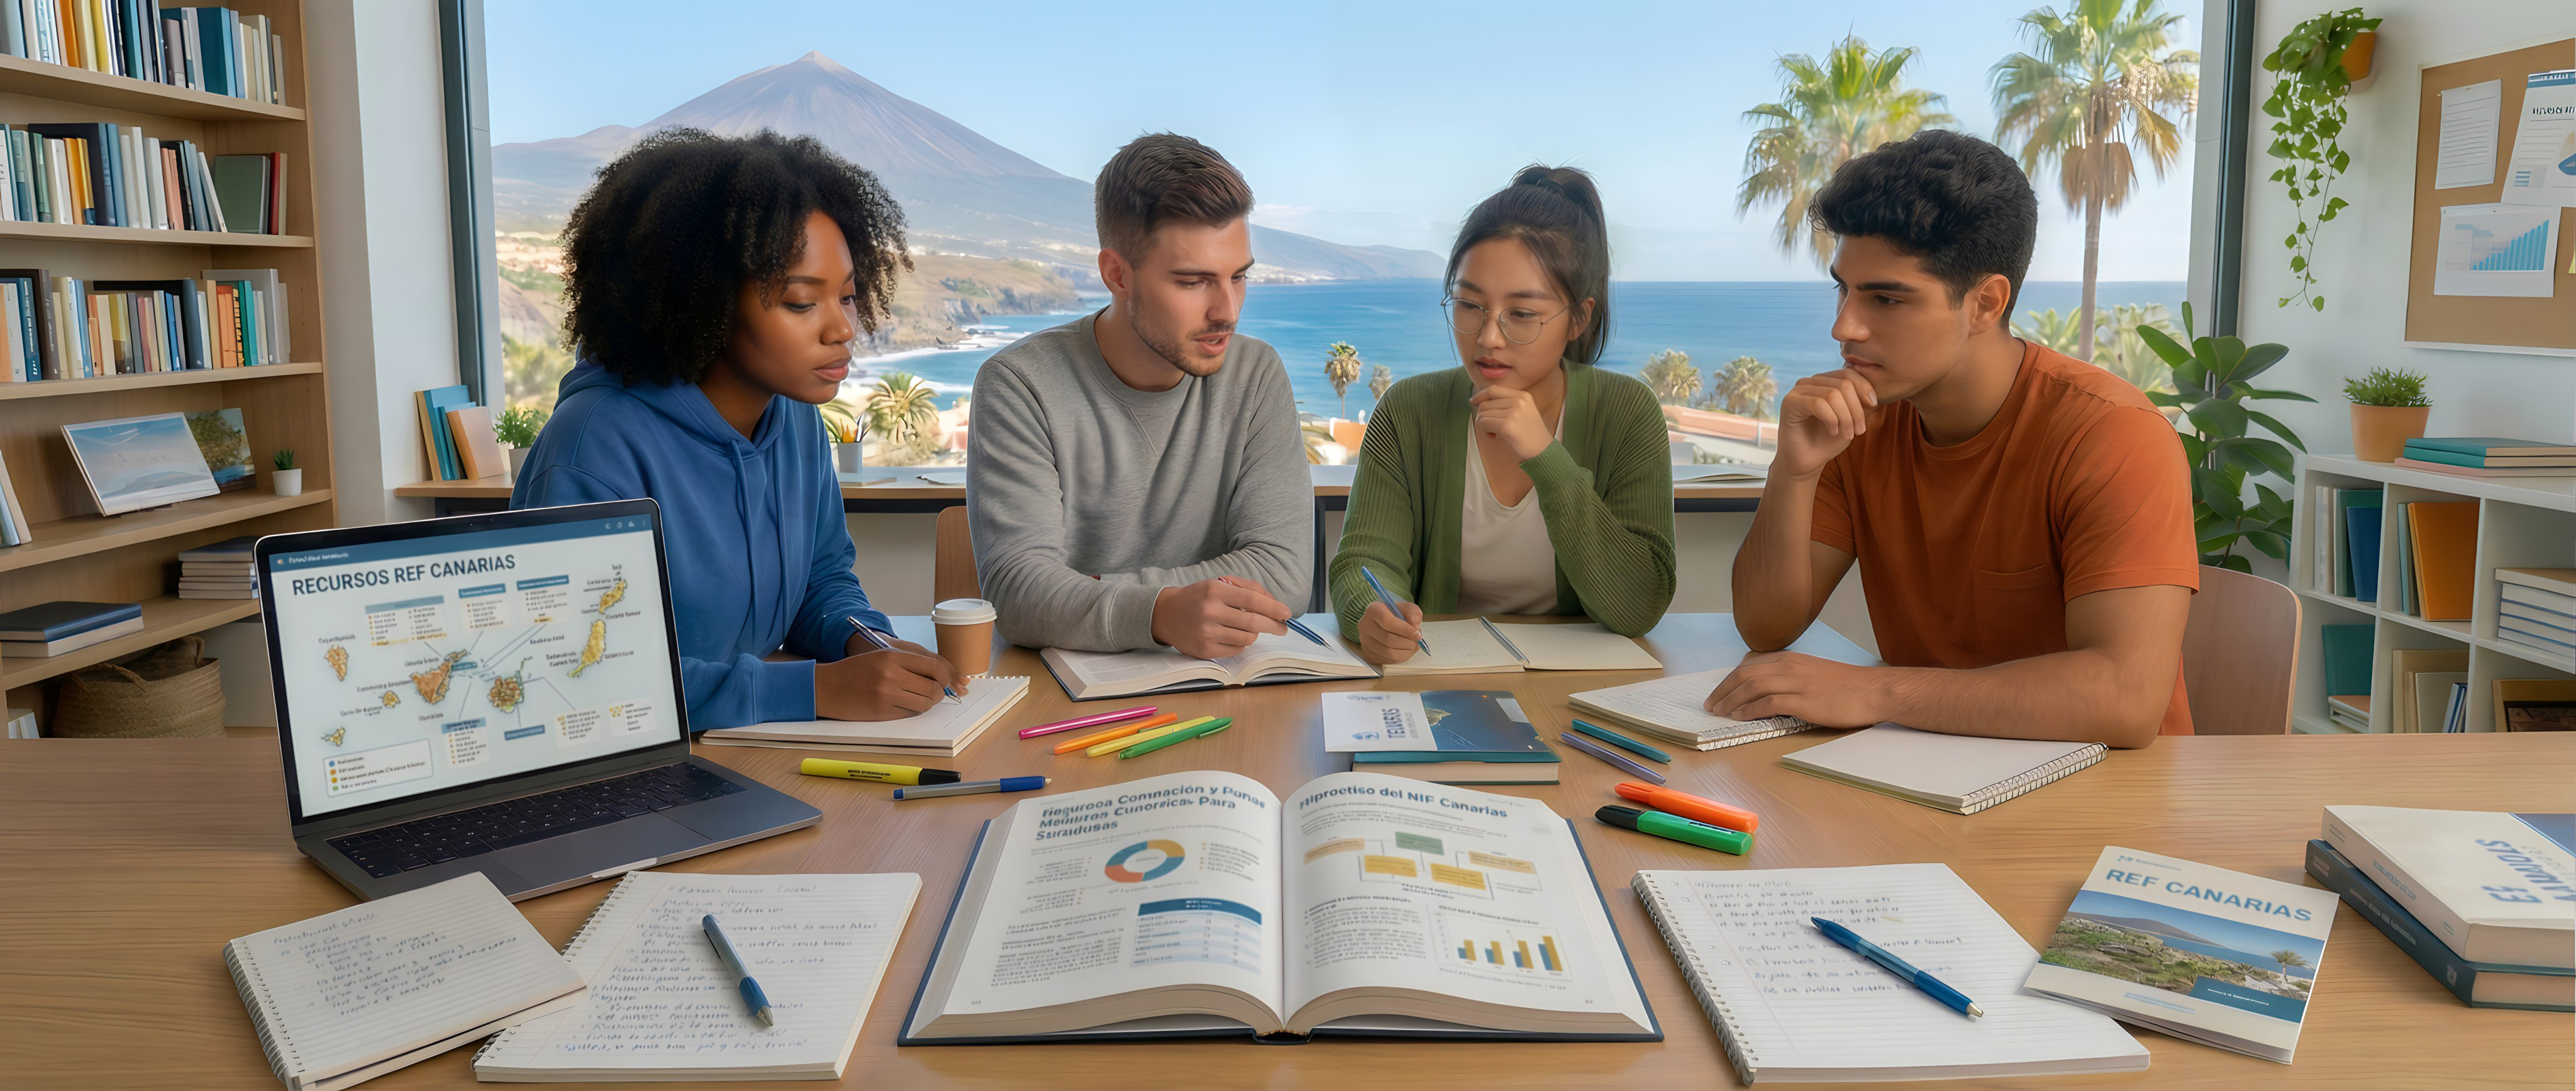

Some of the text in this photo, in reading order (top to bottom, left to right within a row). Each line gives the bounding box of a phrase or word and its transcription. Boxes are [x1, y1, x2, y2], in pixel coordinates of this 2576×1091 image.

[292, 554, 516, 596] RECURSOS REF CANARIAS
[1209, 786, 1219, 795] y
[1407, 787, 1435, 803] NIF
[1440, 798, 1508, 818] Canarias
[2105, 868, 2312, 922] REF CANARIAS
